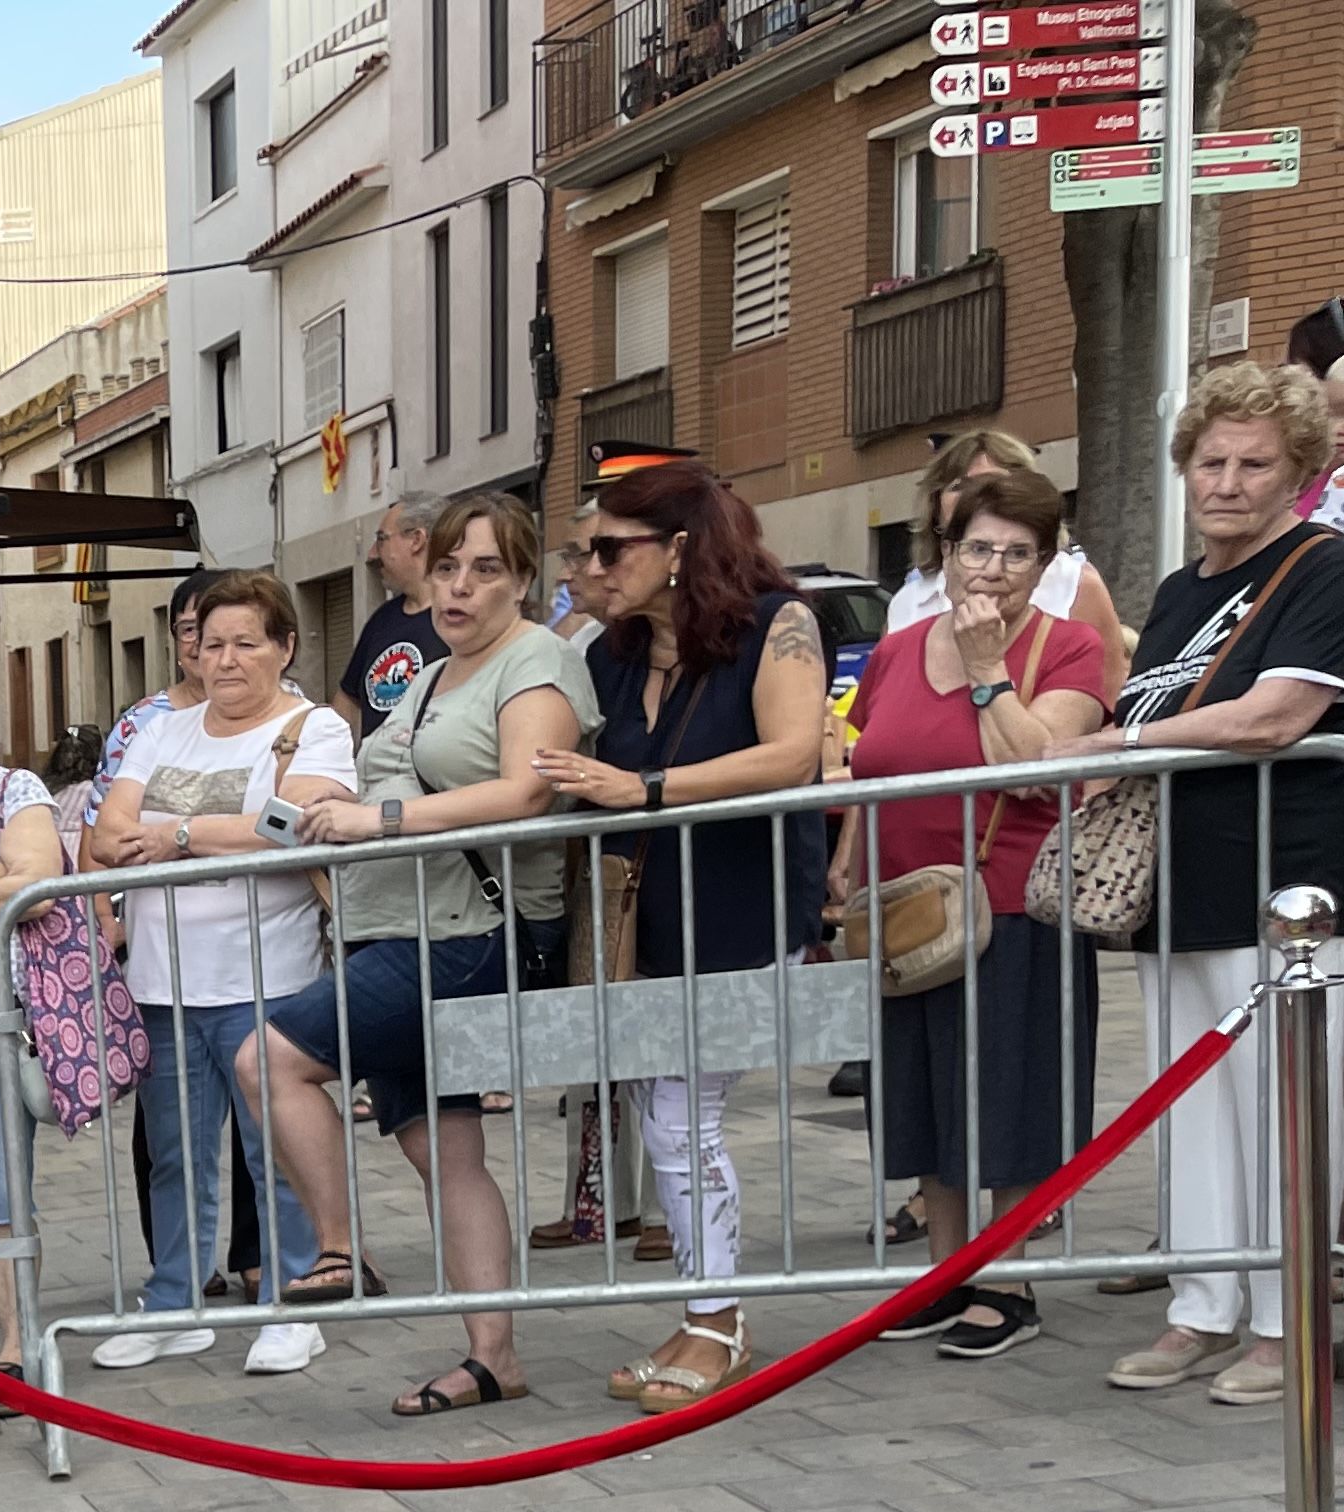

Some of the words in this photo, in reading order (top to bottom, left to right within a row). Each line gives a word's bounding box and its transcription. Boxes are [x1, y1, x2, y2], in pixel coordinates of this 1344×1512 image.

[1037, 10, 1075, 26] Museu
[1065, 60, 1081, 73] de
[1082, 57, 1109, 71] Sant
[1110, 56, 1136, 70] Pere
[985, 121, 1005, 145] P
